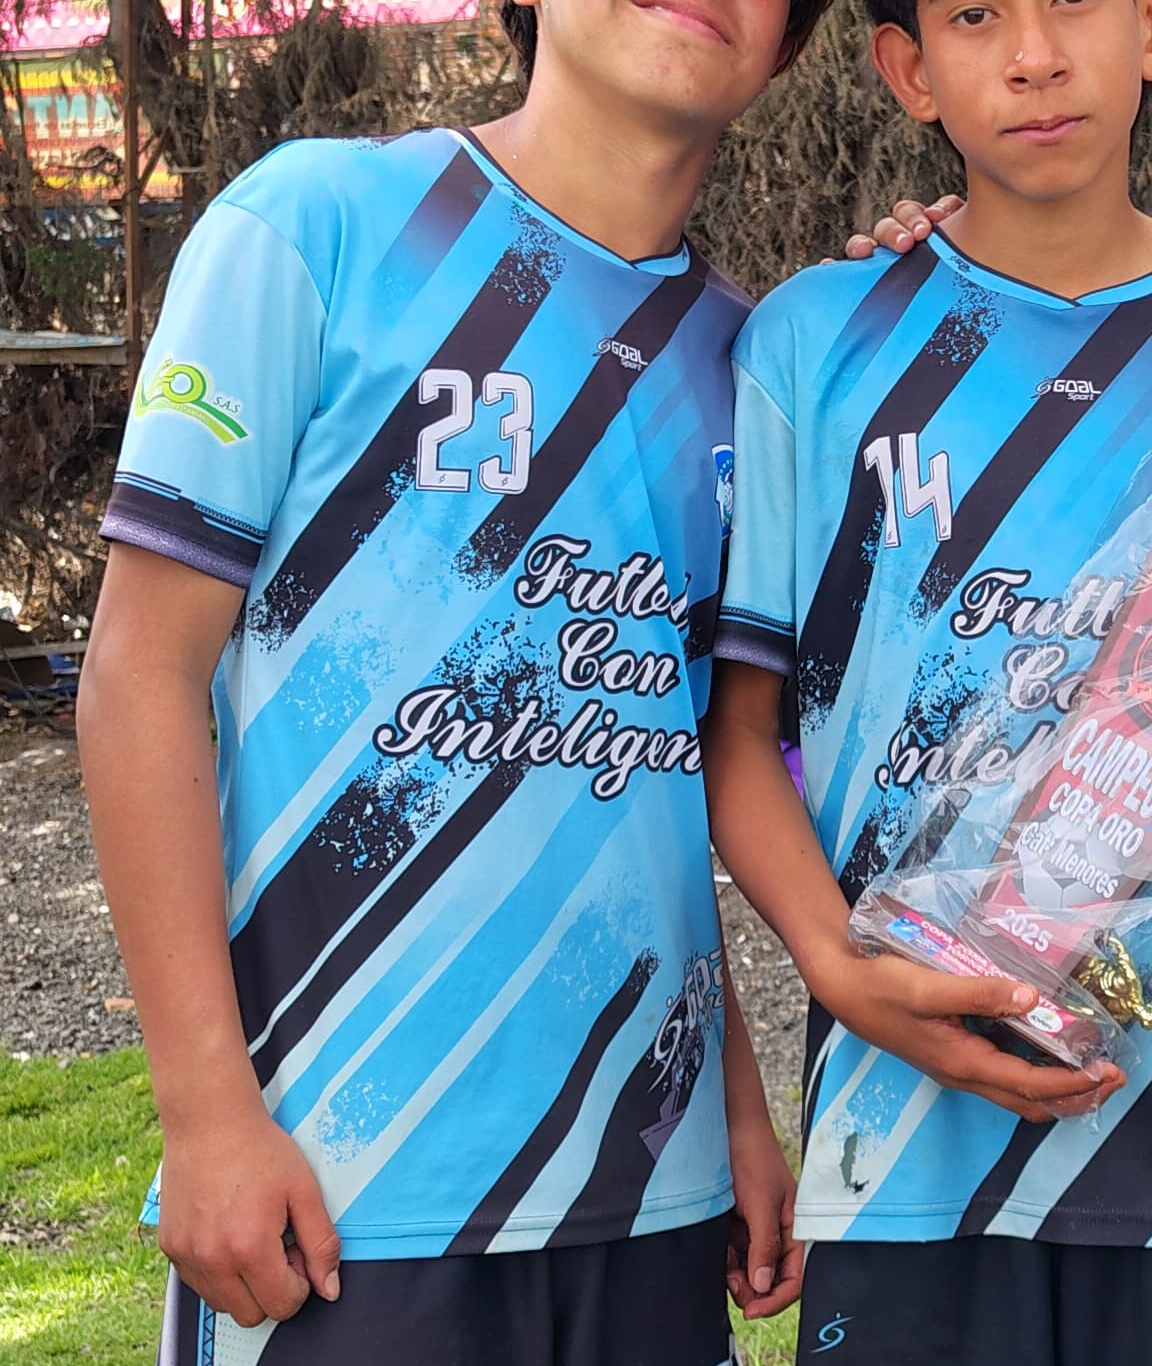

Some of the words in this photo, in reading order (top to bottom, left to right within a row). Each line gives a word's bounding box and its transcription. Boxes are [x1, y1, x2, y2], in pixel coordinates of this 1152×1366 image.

[1053, 379, 1101, 395] GOAL
[415, 368, 535, 494] 23
[863, 432, 953, 548] 14
[558, 618, 681, 698] Con
[377, 688, 703, 803] Inteligen
[1049, 782, 1098, 835] COPA
[1098, 814, 1145, 859] ORO
[1051, 839, 1119, 900] Menores
[998, 907, 1050, 953] 2025
